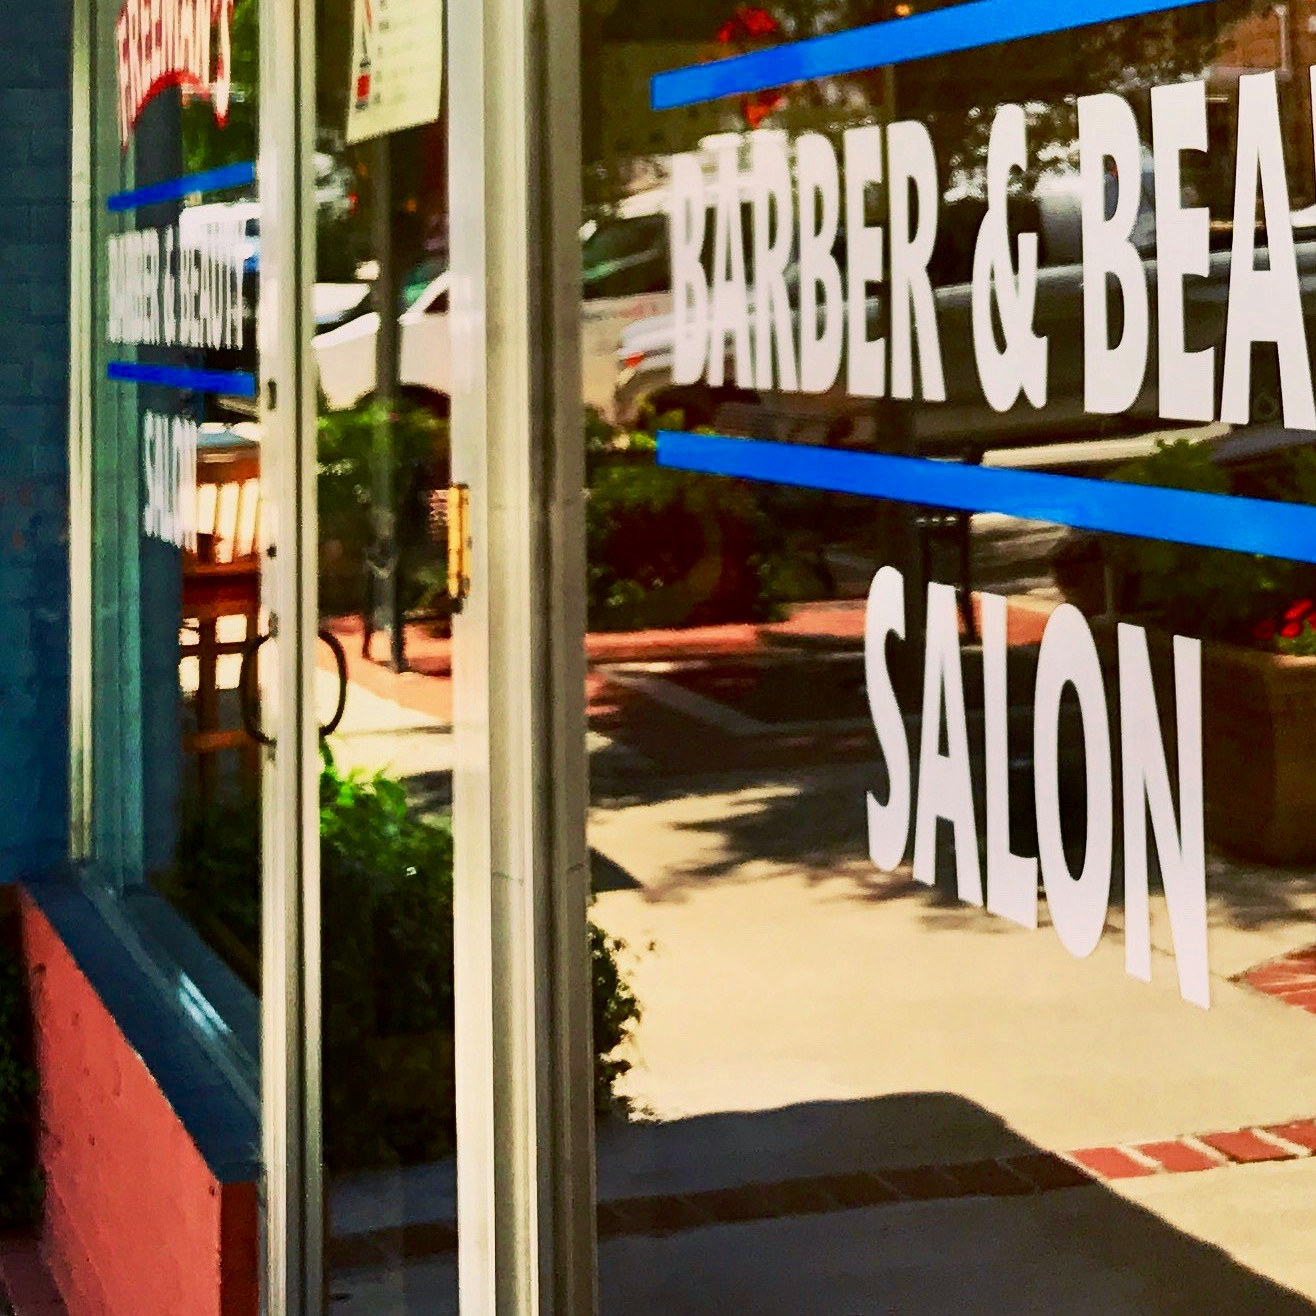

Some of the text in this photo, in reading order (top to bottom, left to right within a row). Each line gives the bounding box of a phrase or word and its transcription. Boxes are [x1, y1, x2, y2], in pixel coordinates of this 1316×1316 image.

[668, 116, 947, 402] BARBER
[973, 102, 1049, 412] &
[864, 565, 1211, 1011] SALON
